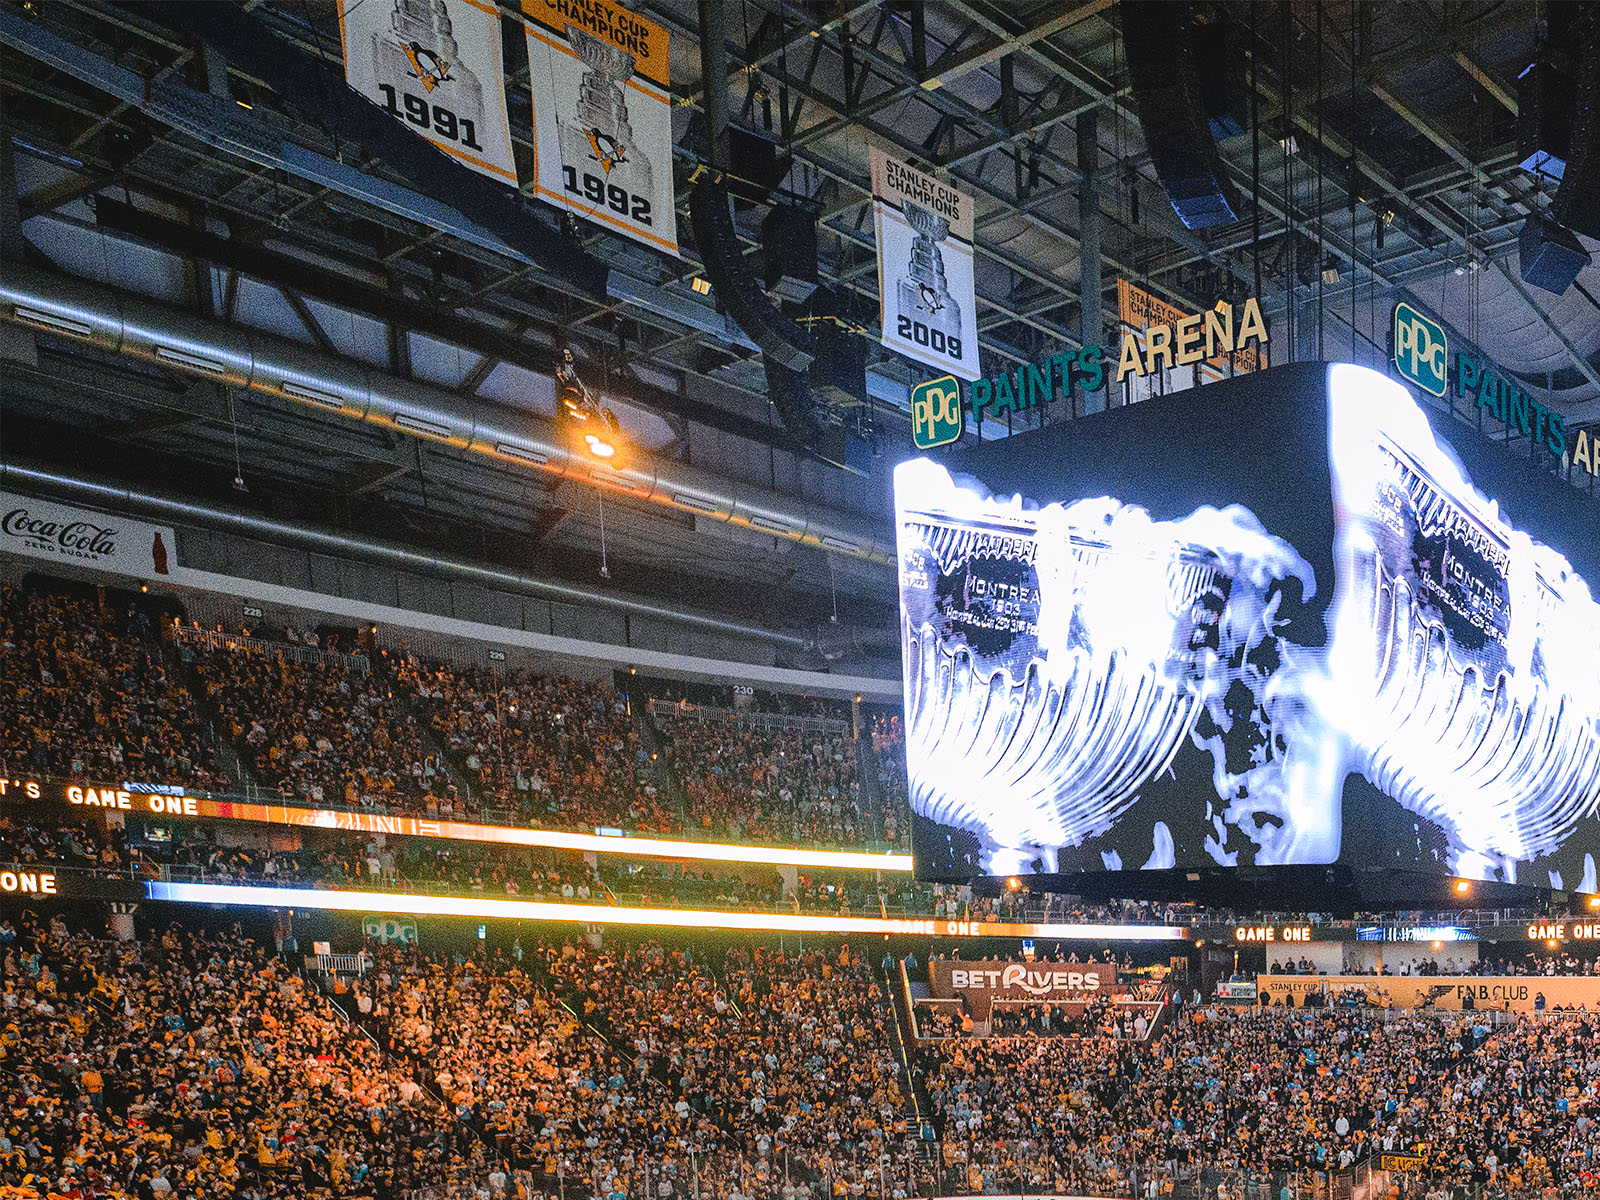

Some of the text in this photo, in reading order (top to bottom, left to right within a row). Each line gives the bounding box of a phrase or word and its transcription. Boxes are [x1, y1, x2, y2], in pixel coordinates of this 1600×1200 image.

[619, 15, 649, 40] CUP
[378, 83, 483, 153] 1991
[563, 165, 653, 227] 1992
[886, 160, 960, 206] STANLEY CUP
[887, 178, 960, 221] CHAMPIONS
[897, 315, 963, 361] 2009
[914, 297, 1270, 440] PPG PAINTS ARENA
[1398, 317, 1446, 381] PPG
[1456, 353, 1567, 456] PAINTS
[2, 508, 119, 555] Coca-Cola
[24, 540, 99, 561] ZERO SUGAR
[965, 573, 1042, 606] MONTREA
[1442, 549, 1513, 622] MONTREA
[733, 685, 753, 696] 230
[0, 779, 41, 799] T'S
[67, 785, 132, 810] GAME
[149, 794, 199, 816] ONE
[0, 871, 57, 895] ONE
[947, 922, 980, 937] ONE
[1235, 927, 1311, 942] GAME ONE
[1528, 924, 1567, 940] GAME
[1492, 985, 1528, 1001] CLUB
